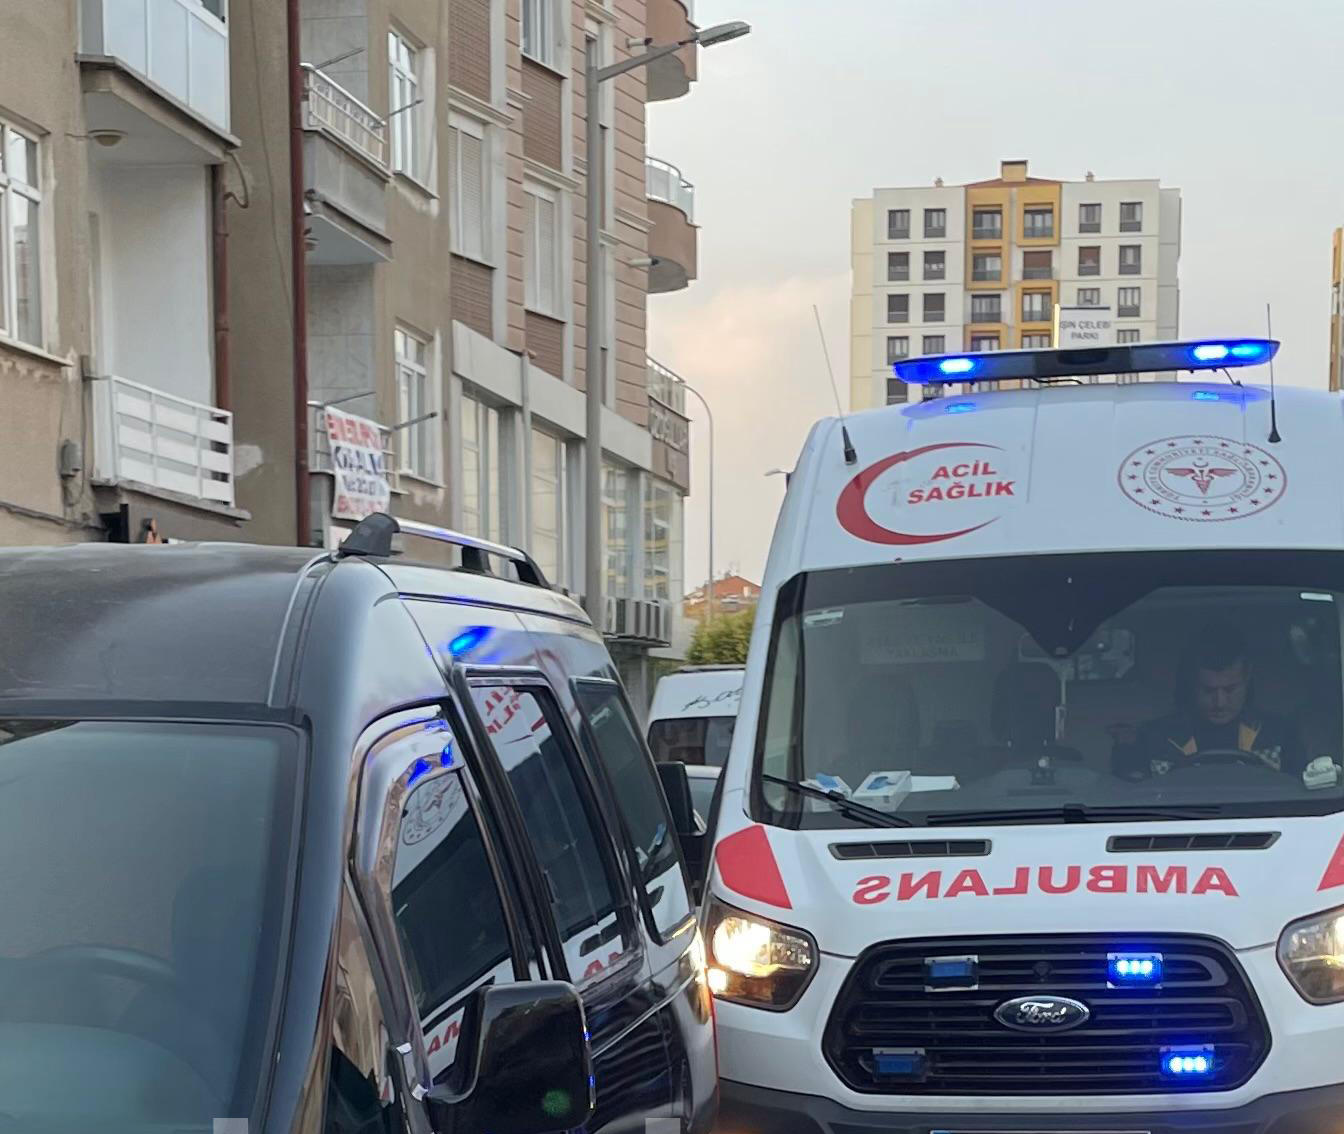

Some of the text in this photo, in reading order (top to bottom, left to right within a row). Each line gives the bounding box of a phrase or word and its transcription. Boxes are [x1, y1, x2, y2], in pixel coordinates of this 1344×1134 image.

[931, 460, 997, 480] ACİL
[908, 481, 1016, 504] SAĞLIK
[1017, 1001, 1067, 1023] Ford
